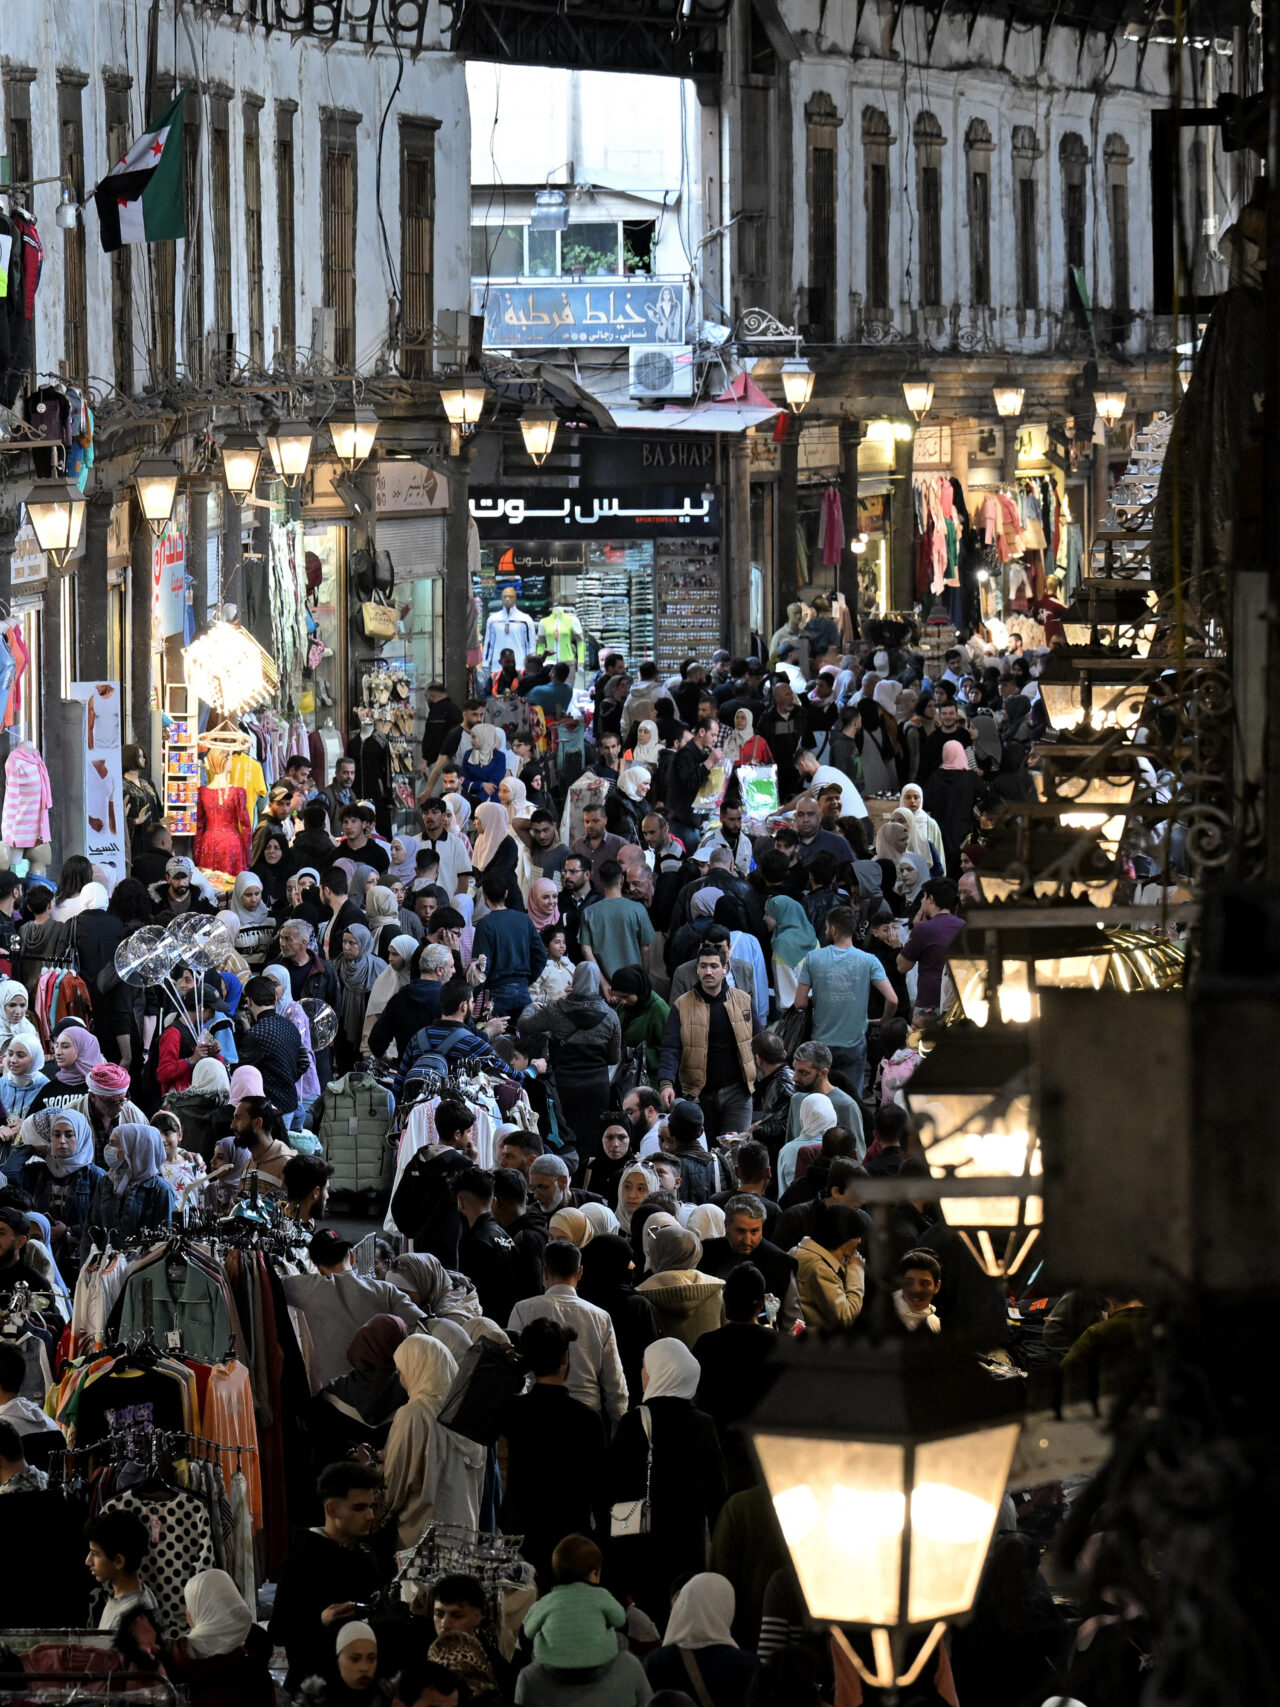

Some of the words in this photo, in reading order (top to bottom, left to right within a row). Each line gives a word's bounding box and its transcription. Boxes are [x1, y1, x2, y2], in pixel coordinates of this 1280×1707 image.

[504, 291, 575, 335] قرطبة
[582, 291, 646, 329] خياط
[468, 498, 571, 525] بوت
